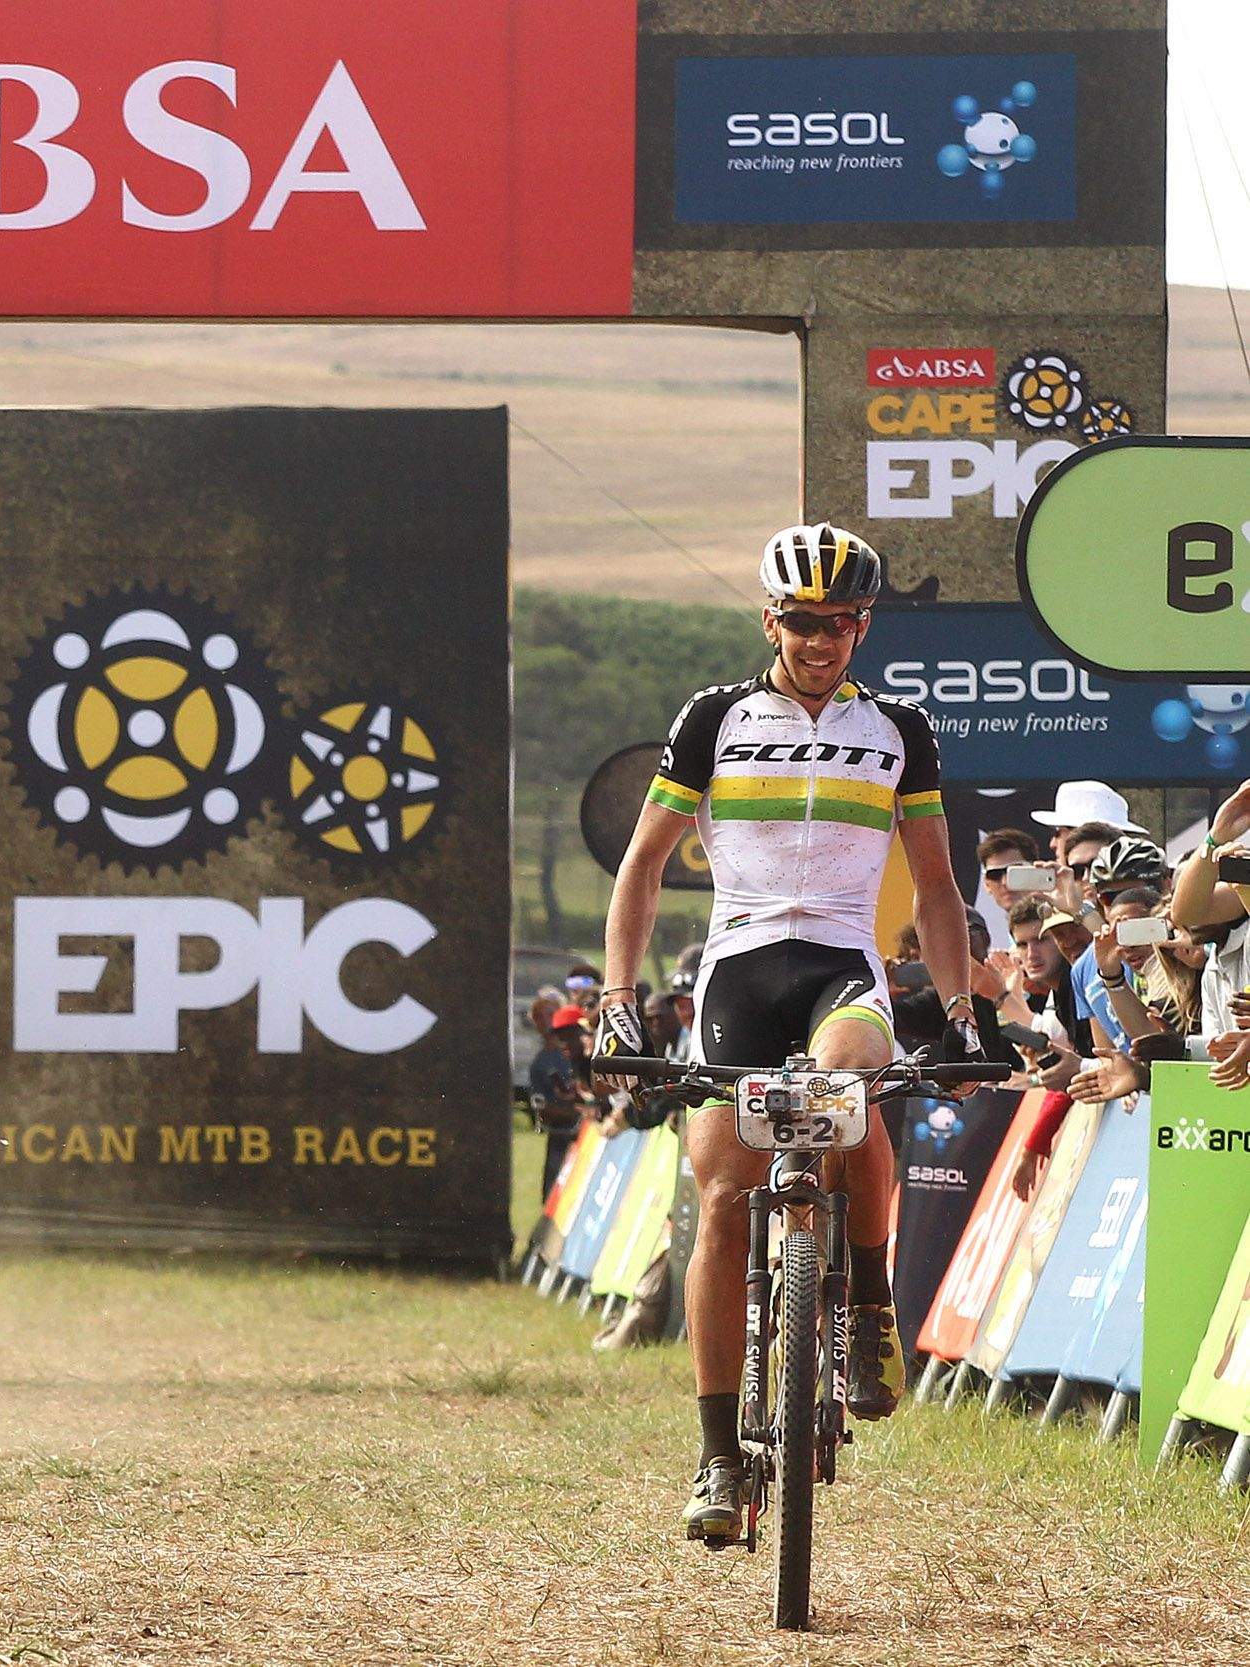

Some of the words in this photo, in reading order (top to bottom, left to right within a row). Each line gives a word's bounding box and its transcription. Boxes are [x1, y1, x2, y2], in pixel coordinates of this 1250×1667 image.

[727, 155, 795, 174] reaching
[800, 157, 832, 171] new
[836, 152, 903, 173] frontiers
[916, 359, 986, 379] ABSA
[867, 394, 996, 434] CAPE
[930, 711, 970, 739] hing
[978, 717, 1019, 733] new
[1023, 711, 1109, 738] frontiers
[716, 742, 901, 772] SCOTT
[13, 895, 438, 1054] EPIC
[773, 1117, 834, 1143] 6-2
[158, 1125, 271, 1164] MTB
[293, 1126, 437, 1167] RACE
[747, 1304, 761, 1336] DT
[746, 1345, 760, 1403] SWISS
